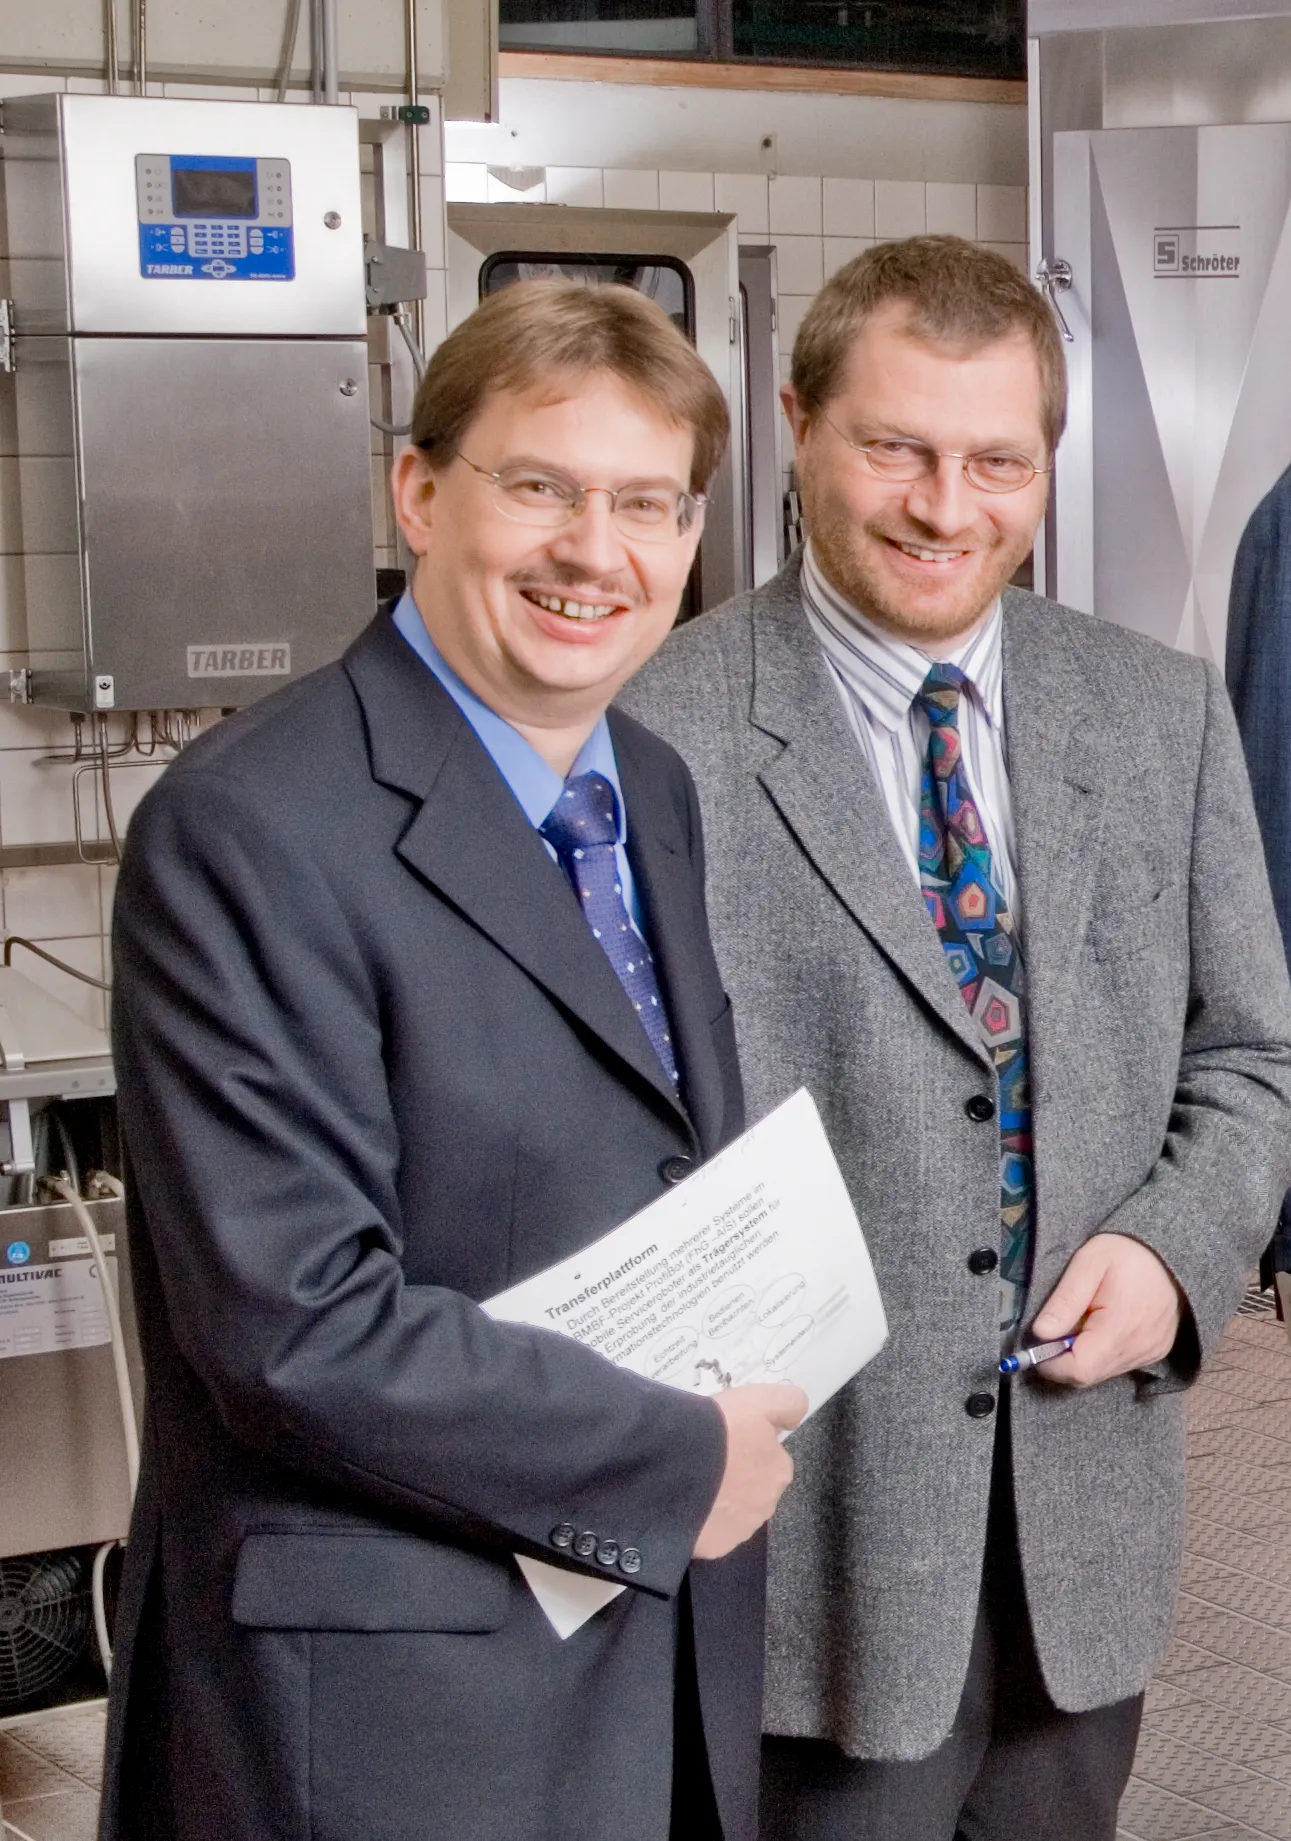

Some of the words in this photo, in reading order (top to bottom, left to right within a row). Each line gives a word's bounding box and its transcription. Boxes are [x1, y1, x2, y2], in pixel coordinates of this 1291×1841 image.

[147, 264, 193, 275] TARBER
[1182, 253, 1240, 272] Schröter
[191, 649, 286, 672] TARBER
[738, 1197, 764, 1222] sollen
[544, 1243, 658, 1320] Transferplattform
[566, 1305, 600, 1330] Durch
[600, 1258, 669, 1309] Bereitstellung
[669, 1224, 711, 1260] mehrerer
[712, 1192, 752, 1226] Systeme
[616, 1274, 685, 1329] Serviceroboter
[687, 1263, 702, 1277] als
[702, 1210, 768, 1263] Trägersystem
[711, 1257, 746, 1288] benutzt
[746, 1230, 779, 1260] werden
[603, 1312, 657, 1353] Erprobung
[660, 1297, 676, 1313] der
[677, 1229, 762, 1299] industrietauglichen
